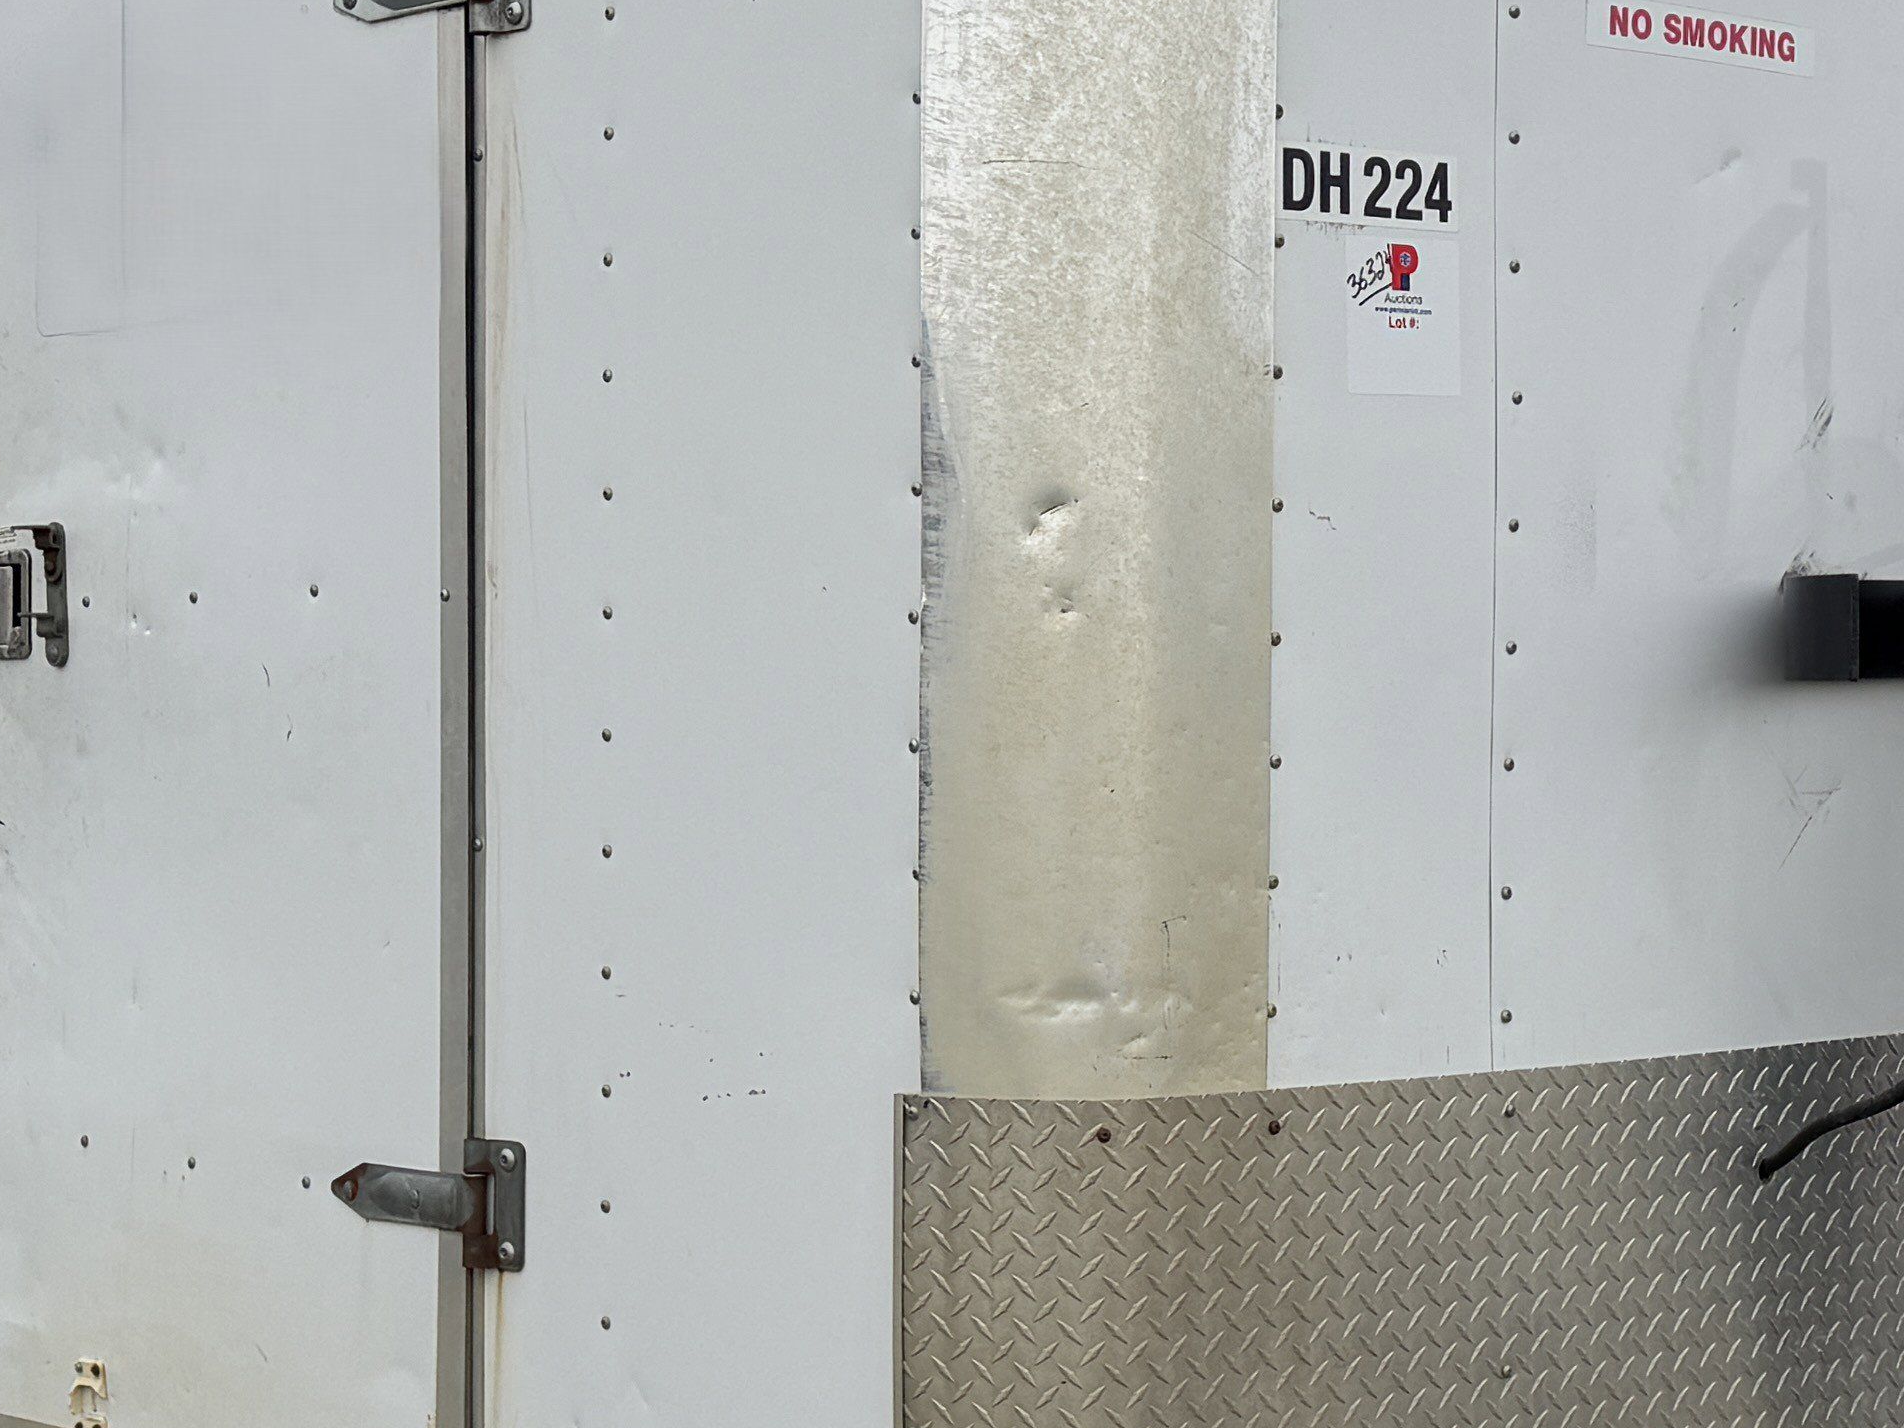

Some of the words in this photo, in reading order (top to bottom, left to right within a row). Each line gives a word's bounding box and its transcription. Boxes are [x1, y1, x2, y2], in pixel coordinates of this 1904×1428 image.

[1609, 4, 1653, 41] NO
[1663, 13, 1796, 63] SMOKING
[1282, 147, 1351, 215] DH
[1363, 155, 1453, 223] 224
